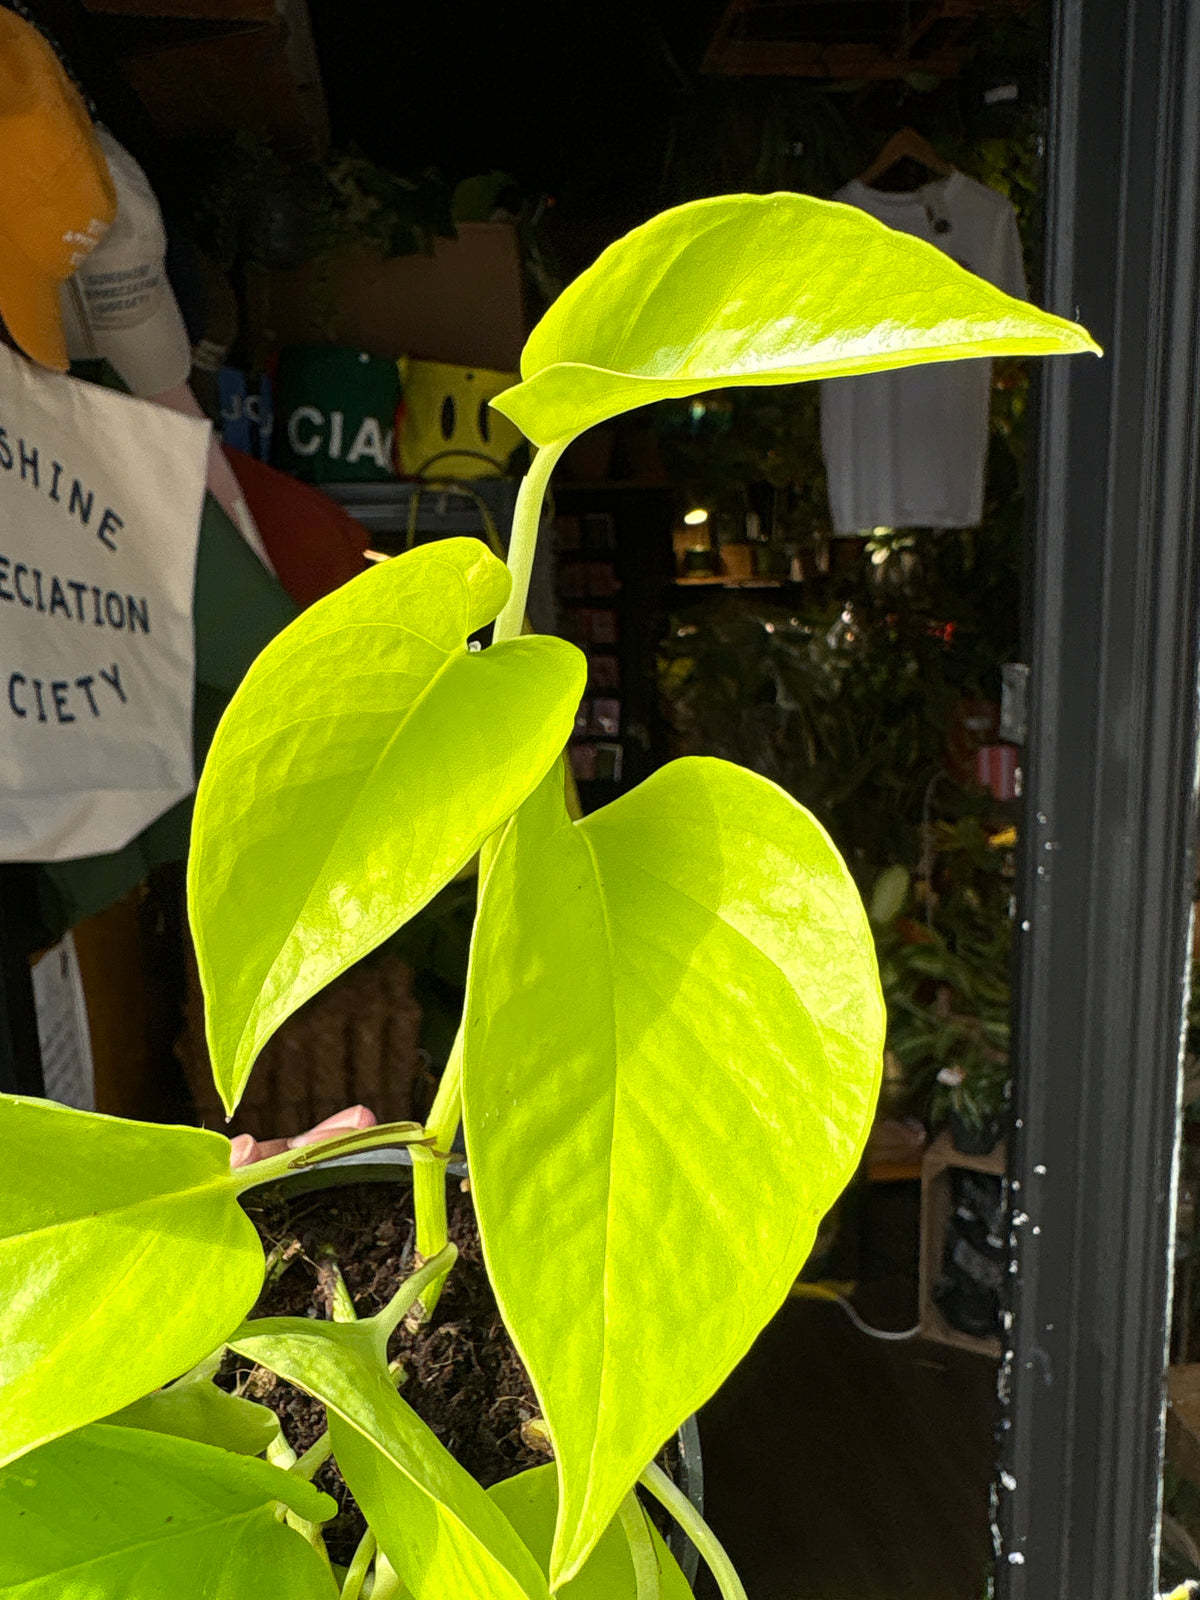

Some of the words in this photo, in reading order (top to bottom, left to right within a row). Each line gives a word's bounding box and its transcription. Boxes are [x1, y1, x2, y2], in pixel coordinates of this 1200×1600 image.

[0, 428, 124, 551] SHINE
[0, 555, 150, 634] ECIATION
[8, 663, 127, 724] CIETY
